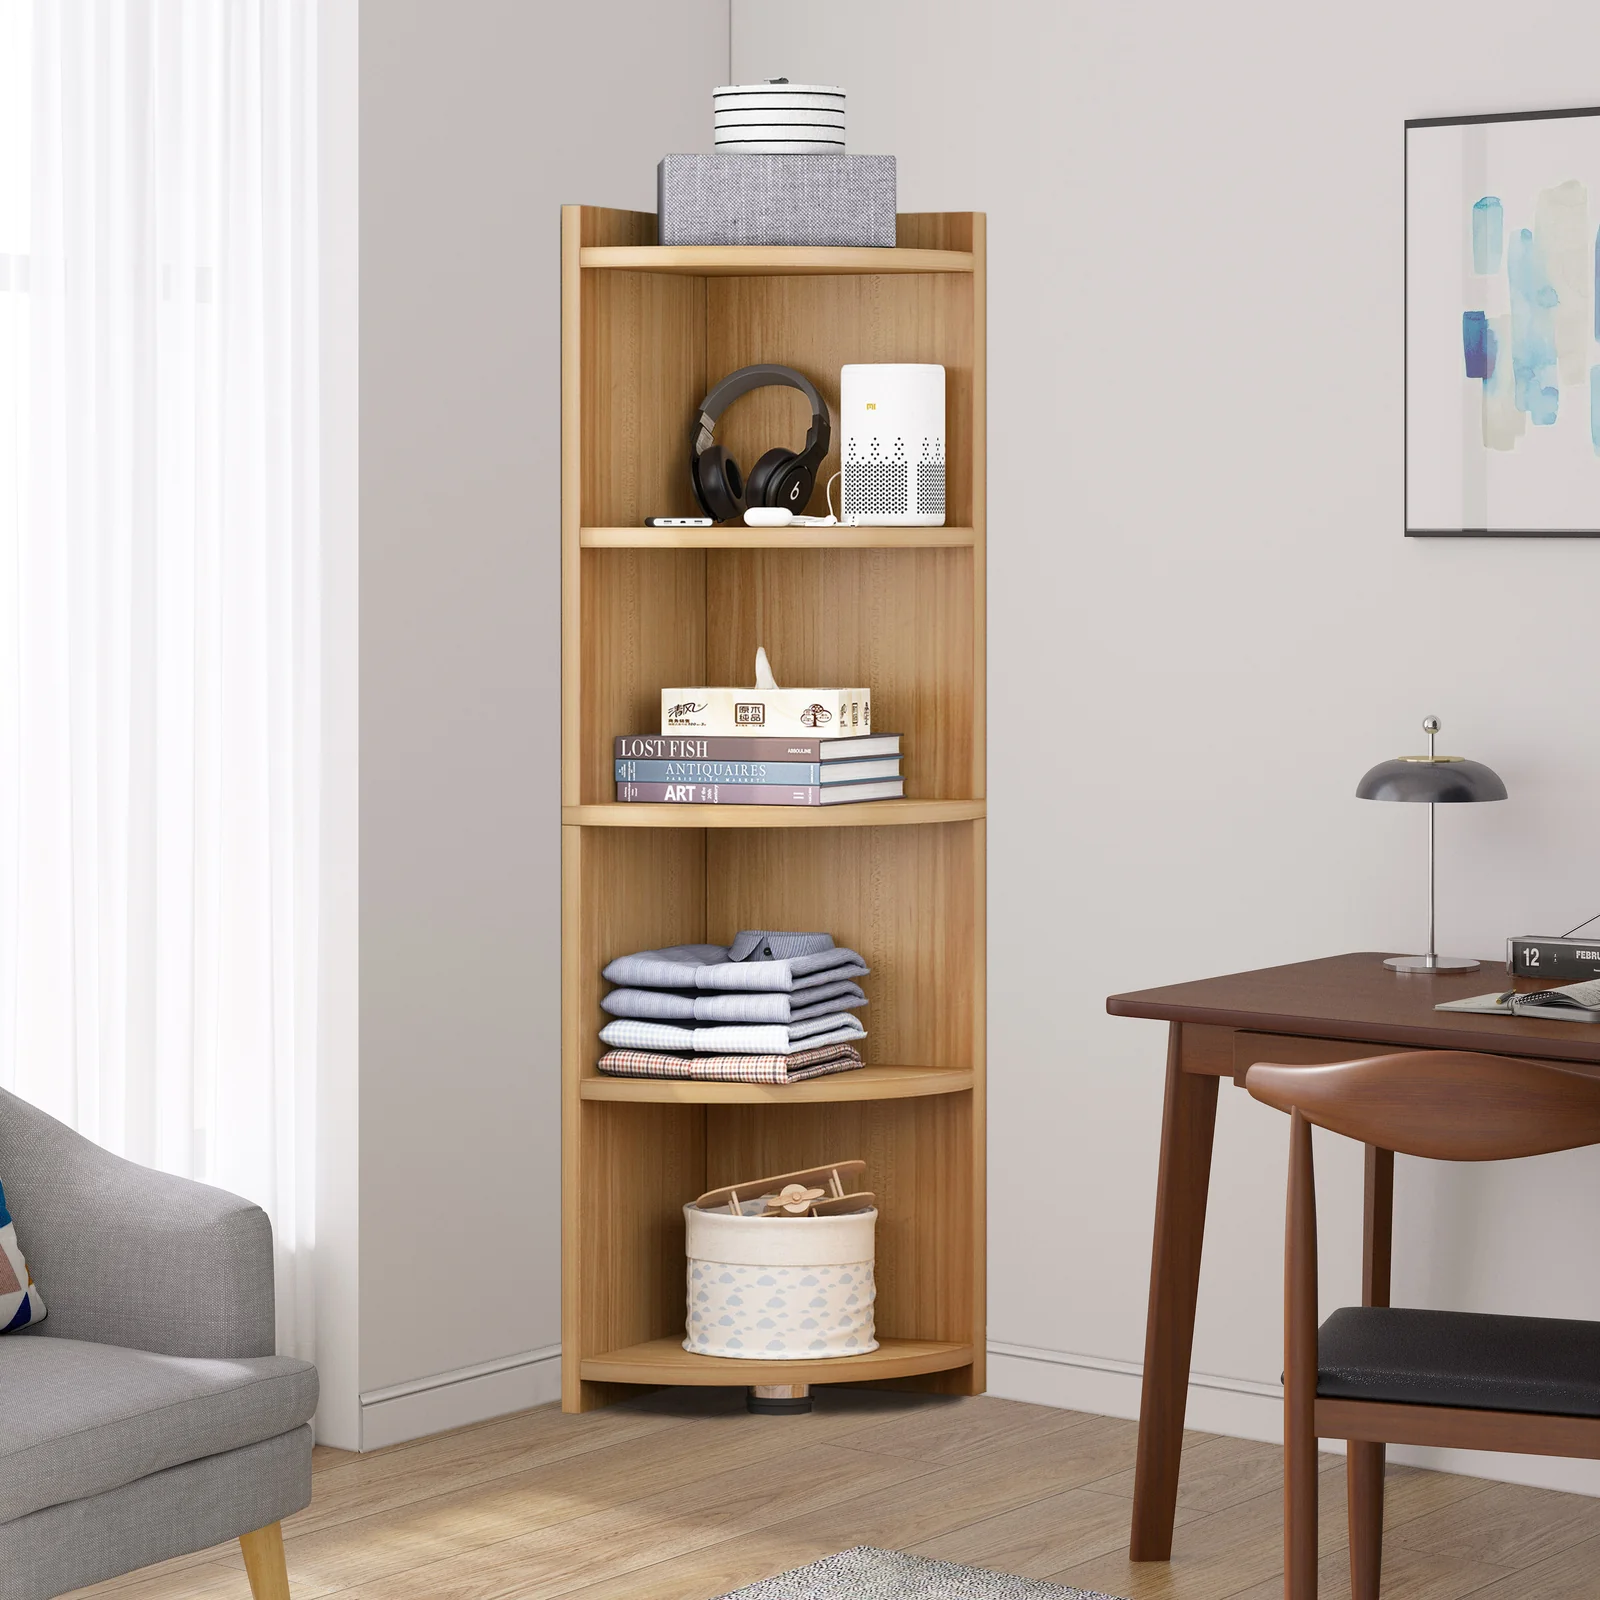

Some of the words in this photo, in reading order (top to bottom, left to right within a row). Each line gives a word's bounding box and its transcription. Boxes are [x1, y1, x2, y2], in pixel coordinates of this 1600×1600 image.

[621, 739, 665, 757] LOST
[669, 740, 708, 758] FISH
[665, 763, 767, 778] ANTIQUAIRES
[664, 785, 696, 802] ART
[1523, 947, 1540, 967] 12
